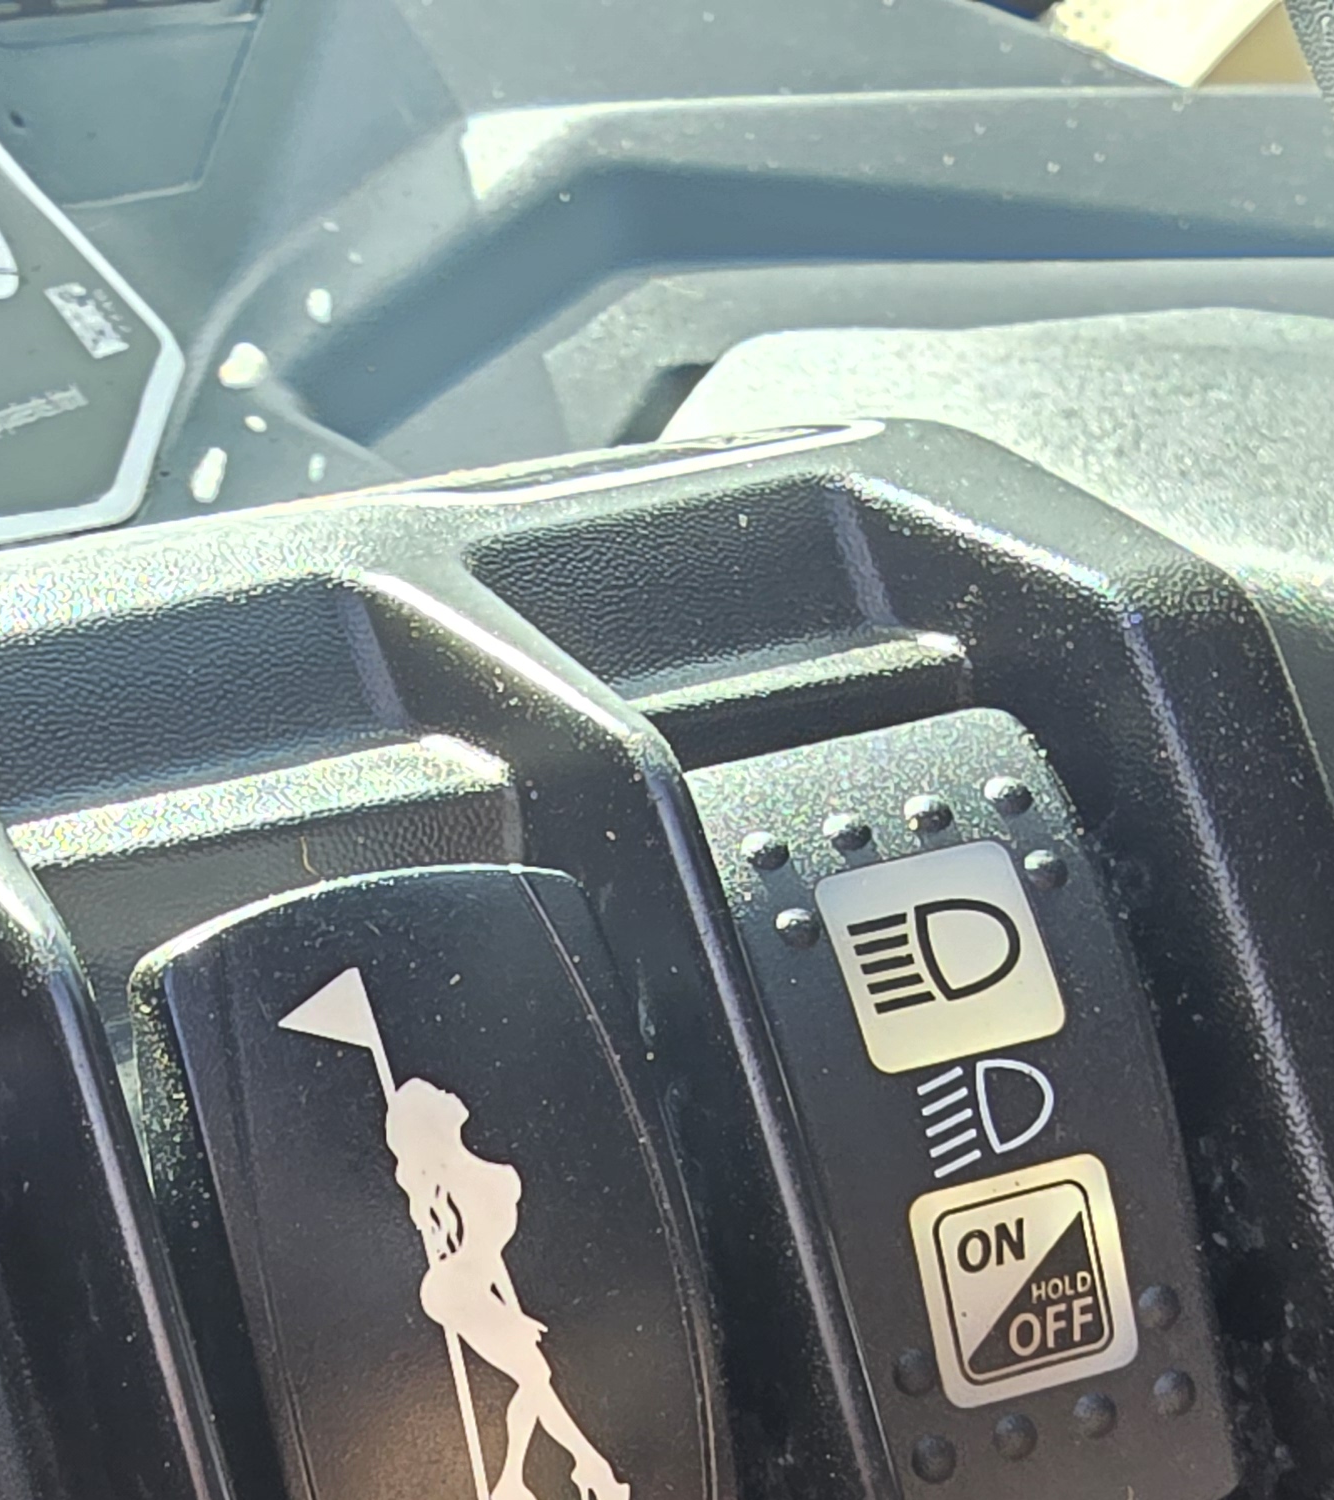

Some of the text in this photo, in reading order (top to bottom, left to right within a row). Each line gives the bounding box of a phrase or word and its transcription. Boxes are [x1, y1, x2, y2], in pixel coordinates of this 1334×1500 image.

[957, 1217, 1026, 1273] ON
[1031, 1271, 1092, 1304] HOLD
[1008, 1296, 1094, 1357] OFF
